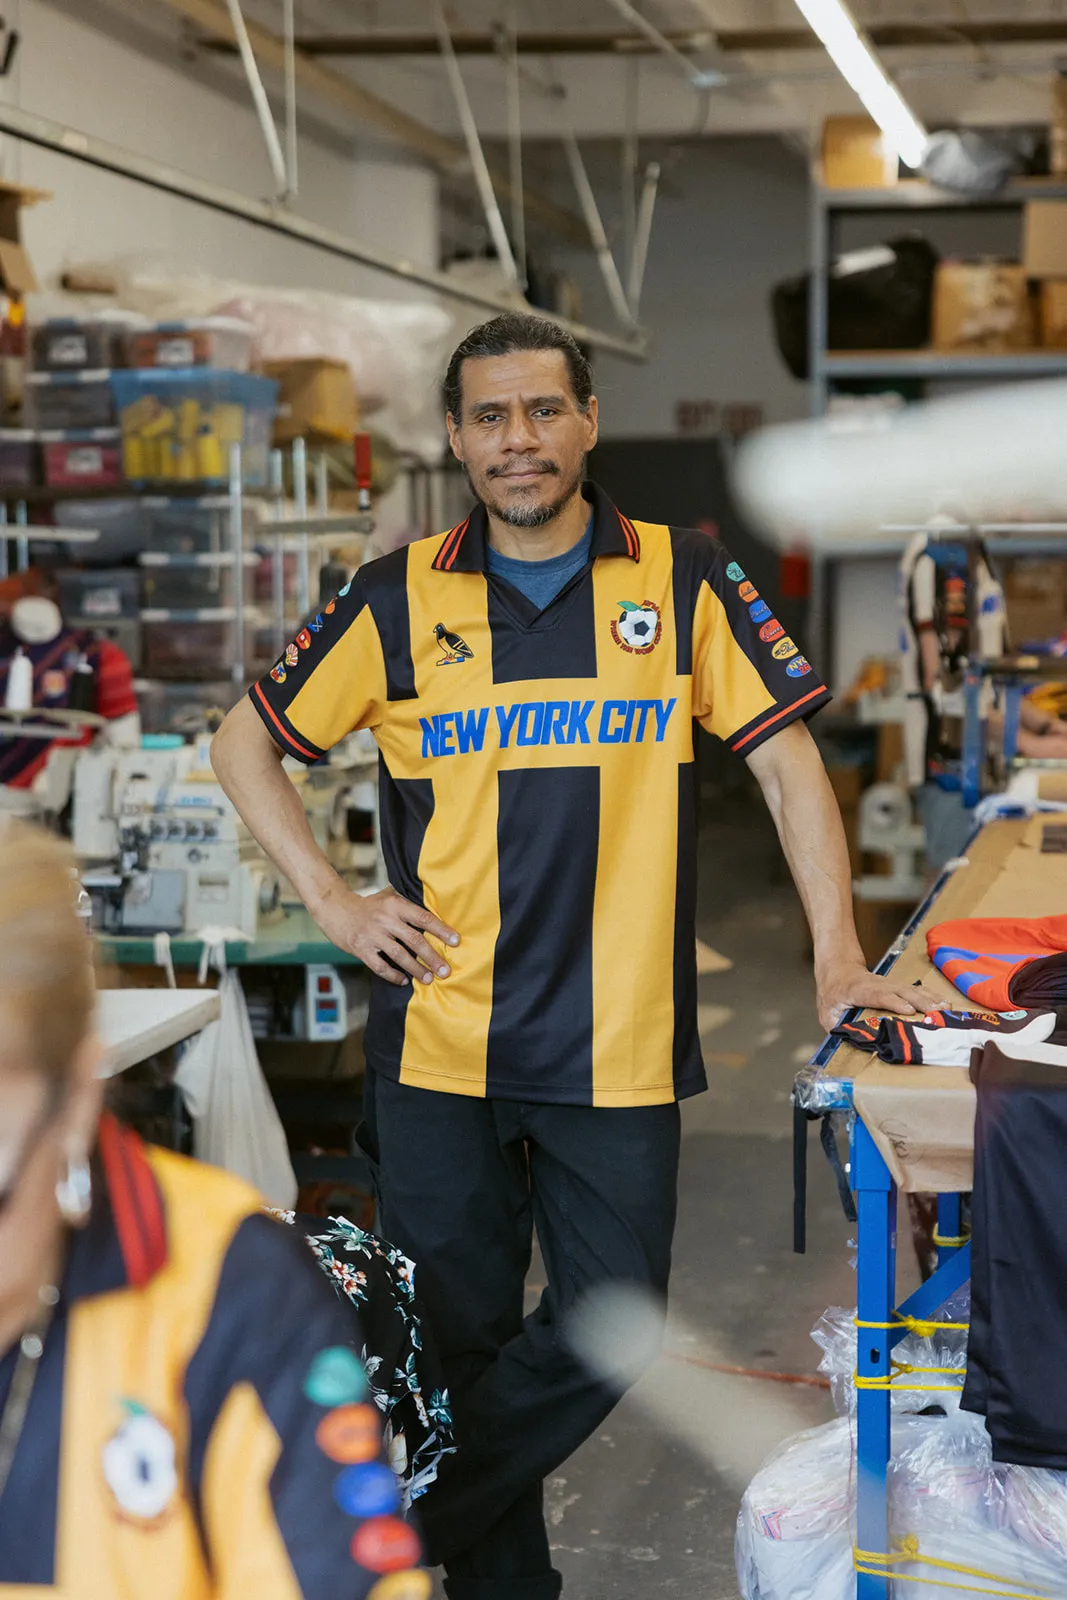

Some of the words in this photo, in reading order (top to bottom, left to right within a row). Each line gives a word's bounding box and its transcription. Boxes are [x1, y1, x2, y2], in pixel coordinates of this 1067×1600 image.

[419, 707, 490, 758] NEW
[495, 700, 595, 748] YORK
[598, 698, 677, 743] CITY
